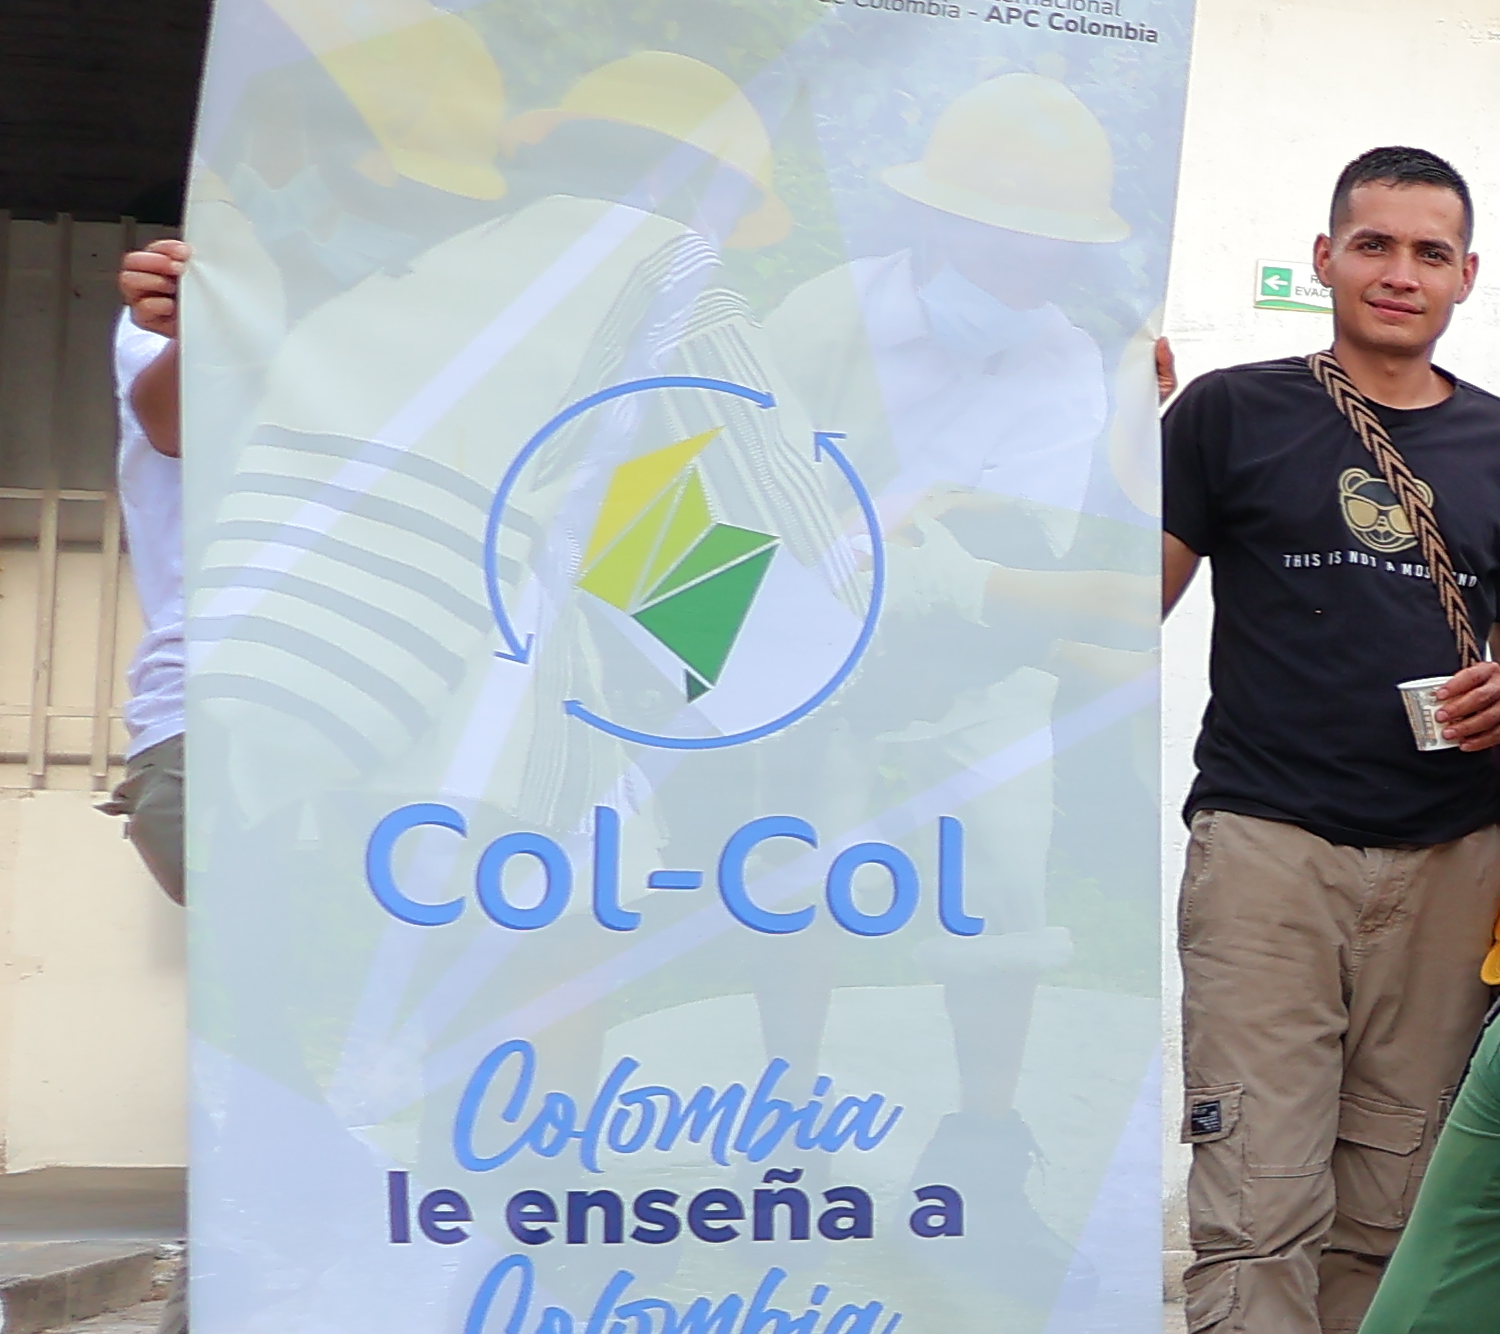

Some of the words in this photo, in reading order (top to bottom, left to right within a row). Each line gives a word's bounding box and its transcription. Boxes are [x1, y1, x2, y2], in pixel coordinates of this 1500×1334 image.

[985, 5, 1040, 28] APC
[1047, 12, 1159, 44] Colombia
[1283, 554, 1322, 568] THIS
[1328, 551, 1342, 565] IS
[1349, 550, 1377, 567] NOT
[1386, 561, 1396, 571] A
[365, 802, 986, 937] Col-Col
[453, 1038, 903, 1174] Colombia
[386, 1169, 474, 1246] le
[505, 1167, 874, 1246] enseña
[909, 1182, 965, 1239] a
